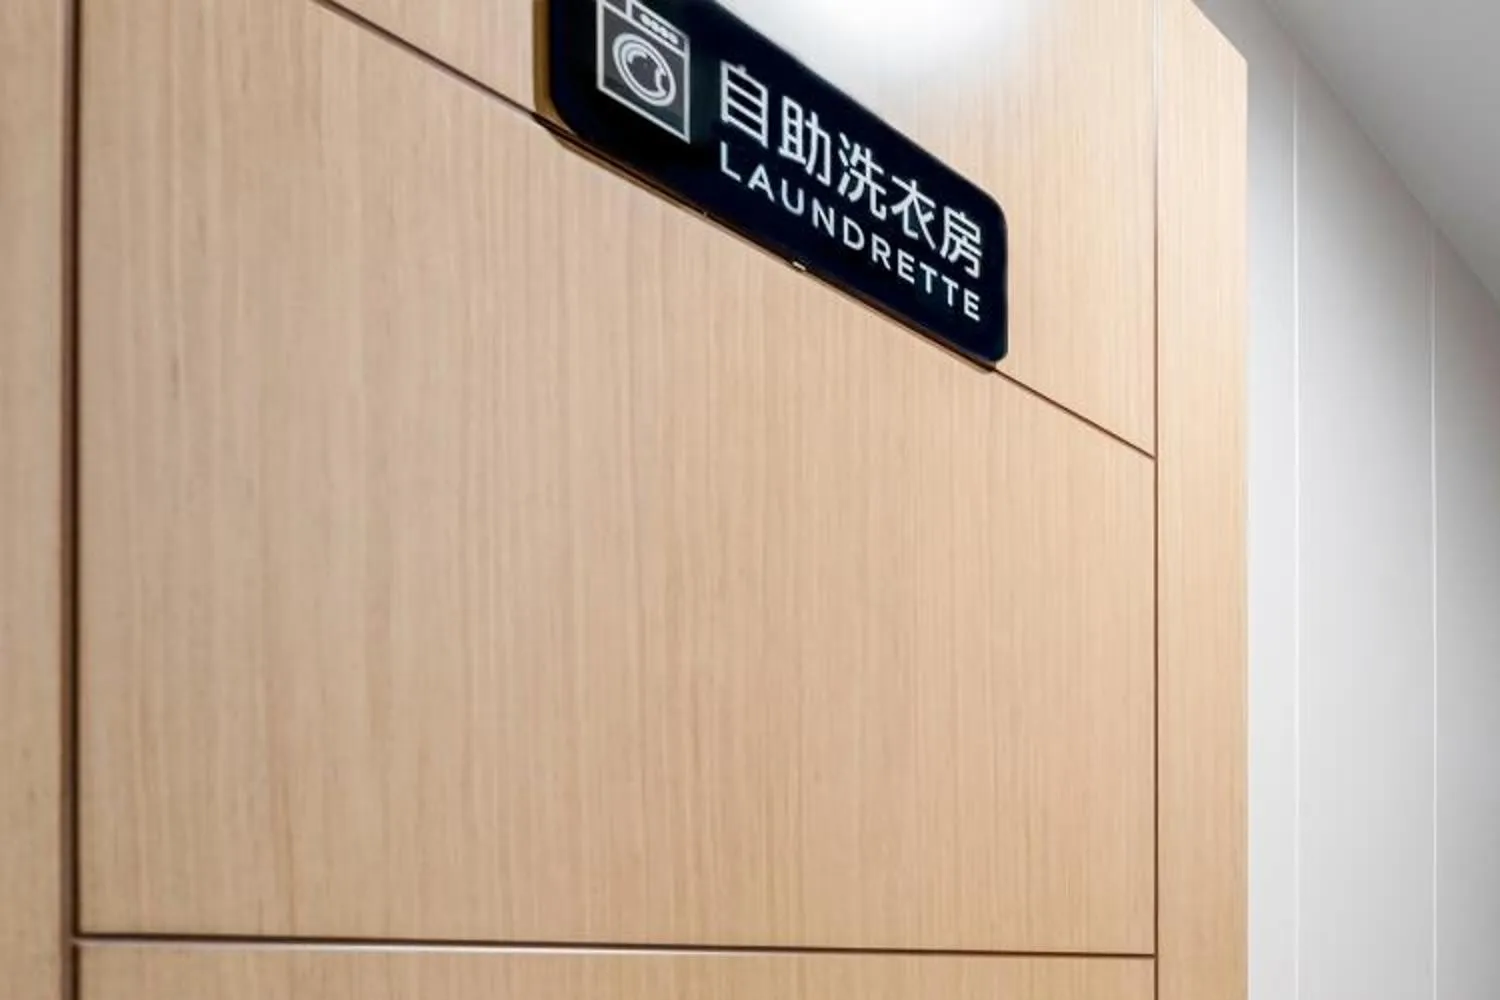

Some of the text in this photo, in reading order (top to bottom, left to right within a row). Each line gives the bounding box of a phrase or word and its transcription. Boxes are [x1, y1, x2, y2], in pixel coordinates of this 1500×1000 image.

[720, 60, 983, 278] 自助洗衣房
[720, 141, 981, 321] LAUNDRETTE
